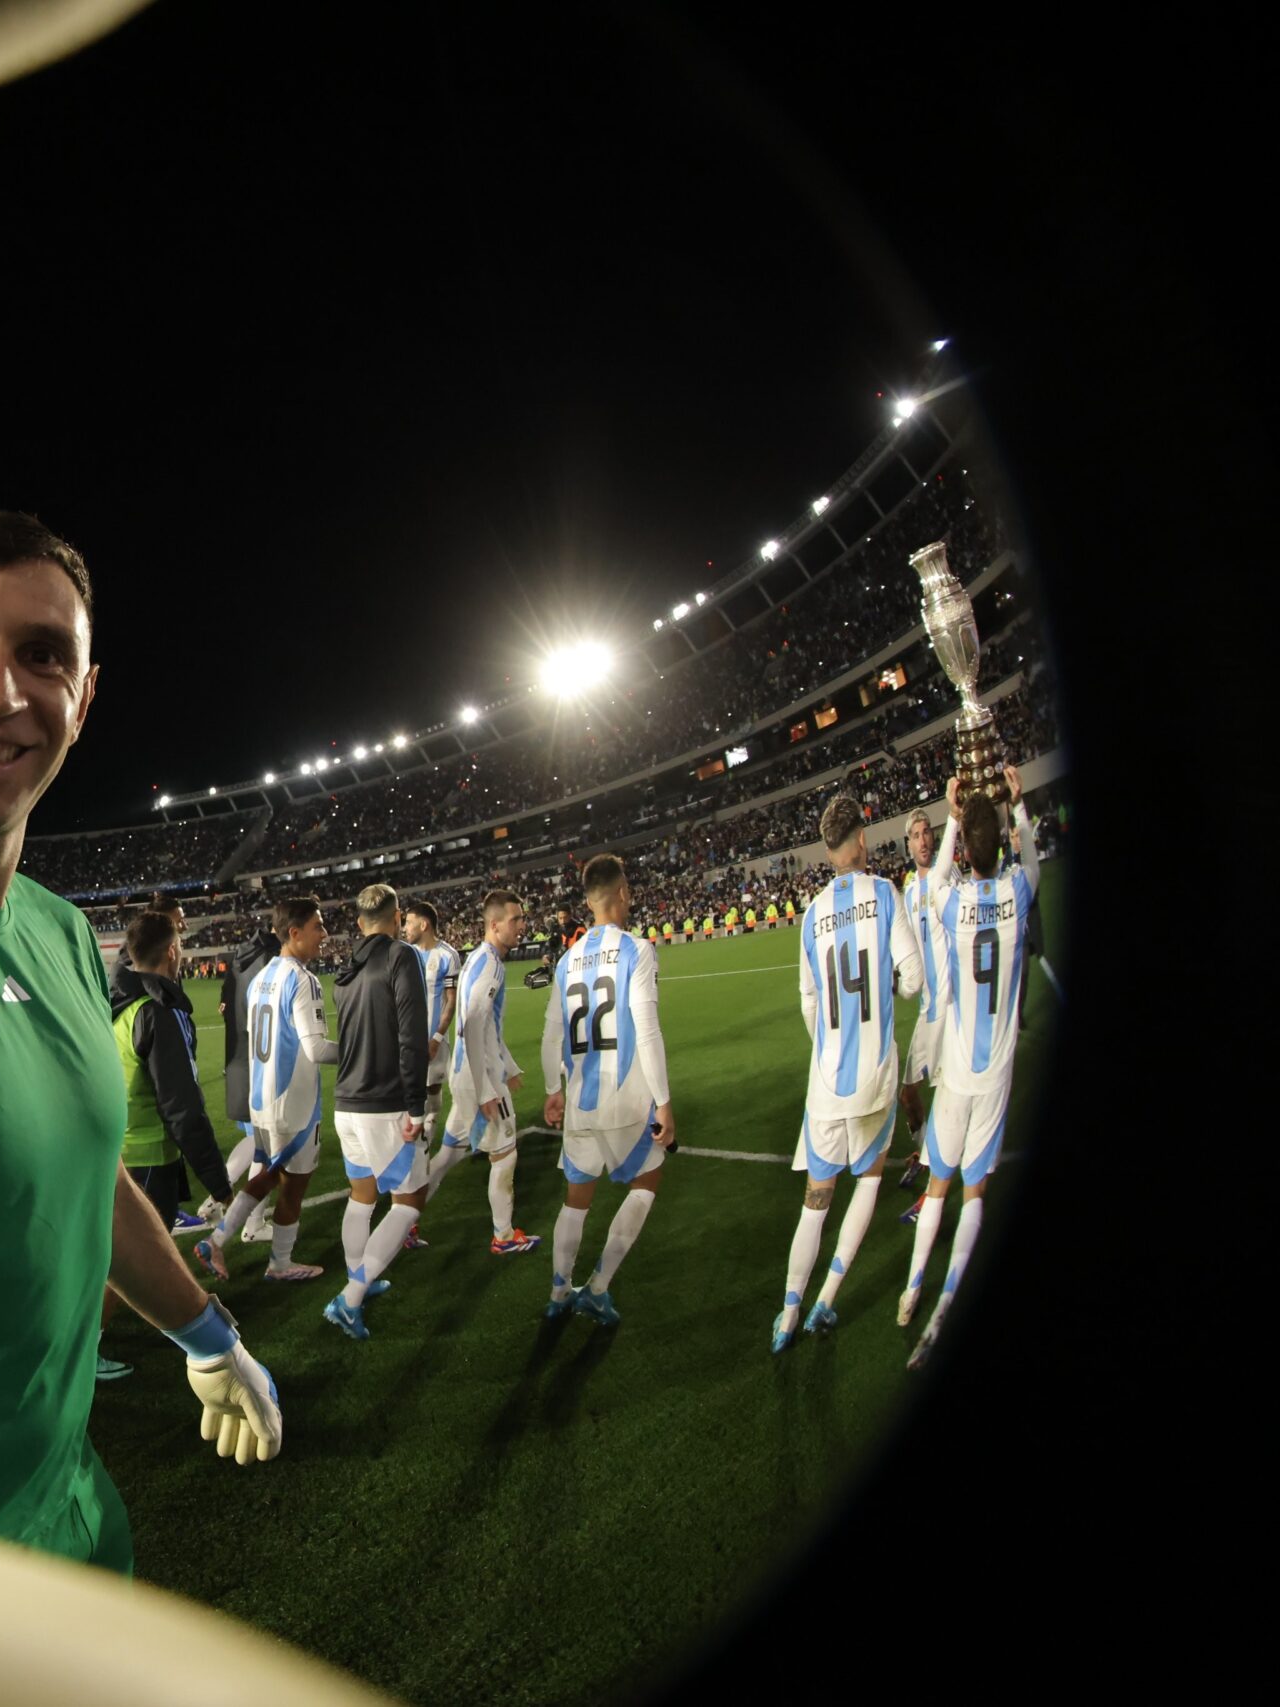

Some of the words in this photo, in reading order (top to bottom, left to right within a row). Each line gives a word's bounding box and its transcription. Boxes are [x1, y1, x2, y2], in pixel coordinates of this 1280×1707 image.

[813, 901, 878, 939] E.FERNANDEZ
[961, 899, 1014, 925] J.ALVAREZ
[826, 940, 871, 1029] 14
[973, 928, 999, 1014] 9
[252, 1003, 273, 1063] 10
[567, 976, 617, 1055] 22
[498, 1097, 510, 1120] 11
